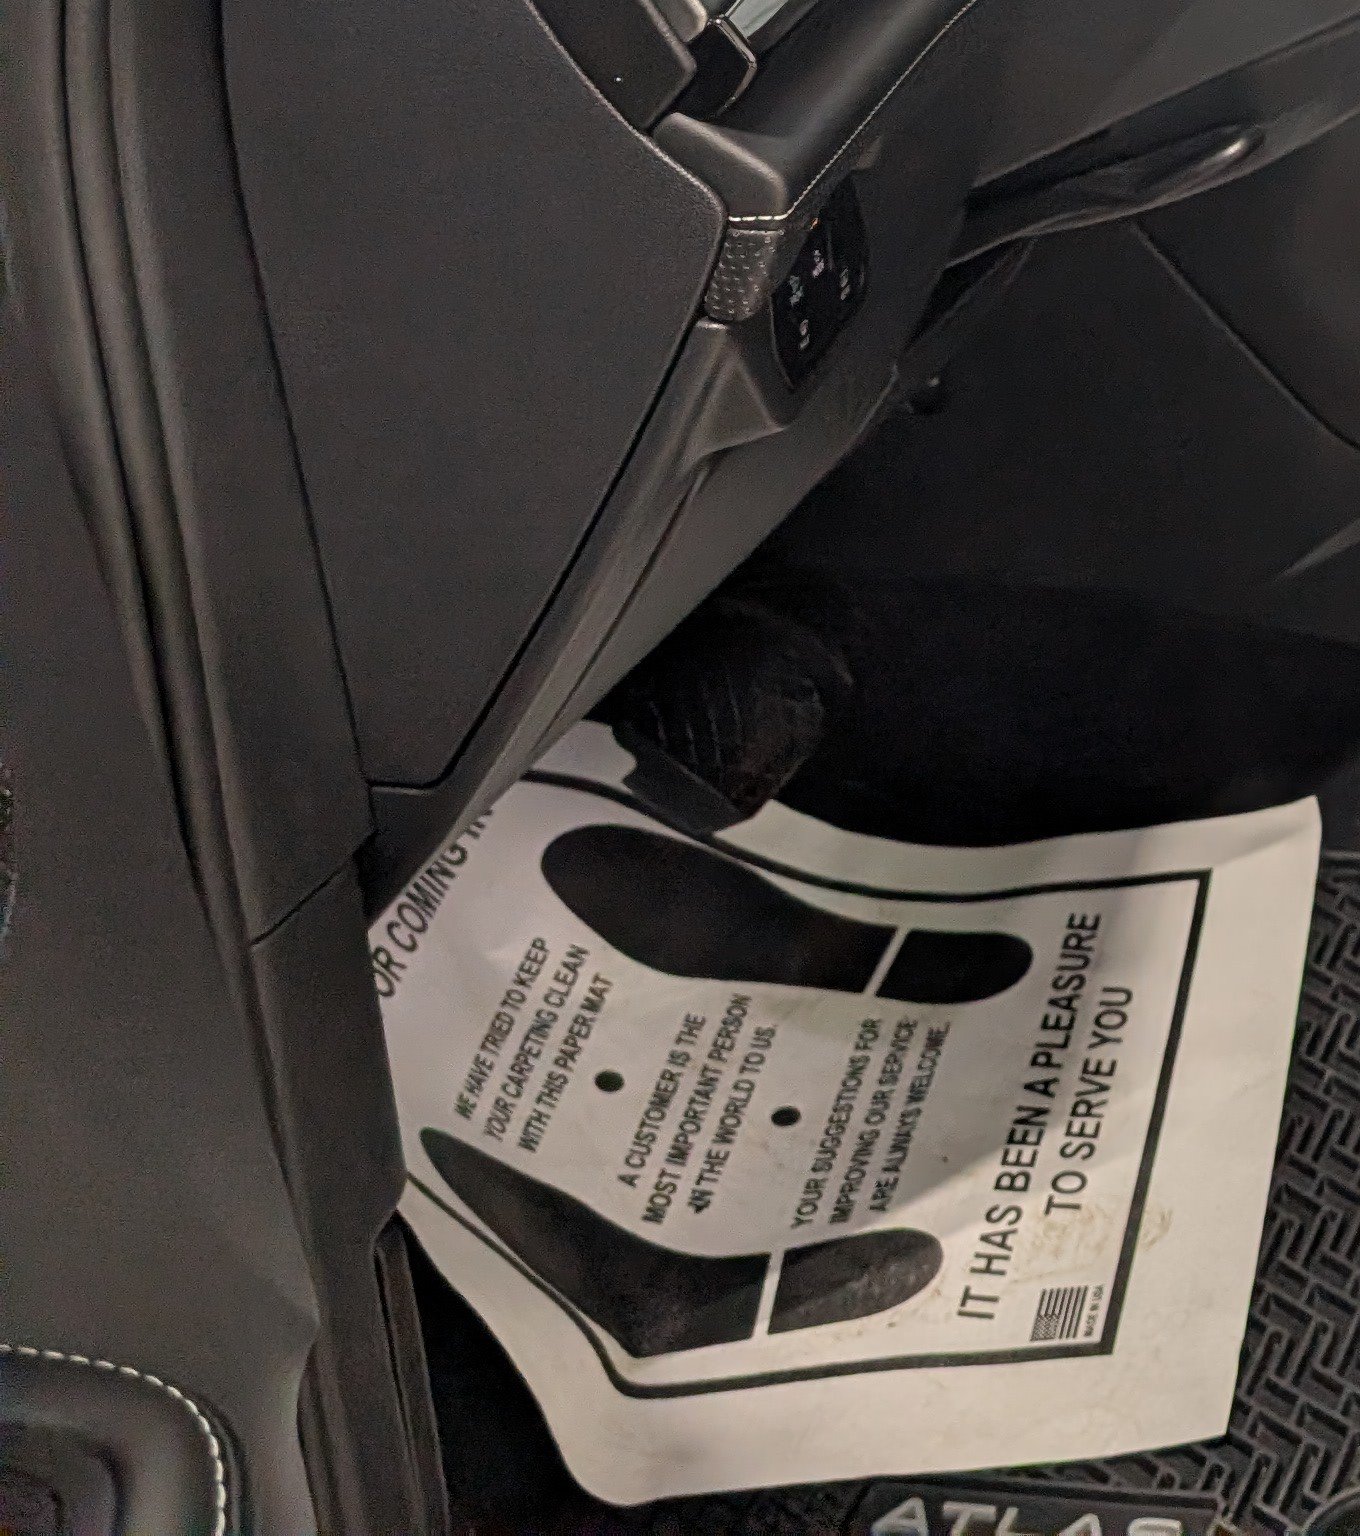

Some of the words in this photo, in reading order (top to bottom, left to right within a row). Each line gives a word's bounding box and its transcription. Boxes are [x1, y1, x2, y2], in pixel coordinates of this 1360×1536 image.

[387, 844, 468, 952] COMING
[513, 937, 549, 989] KEEP
[1030, 912, 1102, 1072] PLEASURE
[501, 988, 527, 1011] TO
[676, 1012, 706, 1046] THE
[1089, 986, 1134, 1053] YOU
[480, 1012, 515, 1056] TRIED
[484, 1096, 515, 1142] YOUR
[500, 1009, 559, 1099] CARPETING
[543, 944, 590, 1008] CLEAN
[518, 1108, 551, 1153] WITH
[536, 1070, 569, 1109] THIS
[554, 1014, 596, 1072] PAPER
[581, 971, 614, 1015] MAT
[666, 1050, 691, 1067] IS
[878, 1015, 919, 1087] SERVICE
[455, 1092, 477, 1120] WE
[464, 1054, 494, 1097] HAVE
[641, 1168, 682, 1225] MOST
[664, 1063, 723, 1167] IMPORTANT
[707, 992, 752, 1063] PERSON
[864, 1088, 896, 1126] OUR
[1023, 1076, 1059, 1101] A
[624, 1069, 682, 1168] CUSTOMER
[695, 1149, 729, 1186] THE
[712, 1079, 756, 1145] WORLD
[739, 1051, 766, 1076] TO
[790, 1177, 828, 1229] YOUR
[811, 1054, 871, 1173] SUGGESTIONS
[855, 1017, 882, 1051] FOR
[882, 1107, 923, 1173] ALWAYS
[1059, 1058, 1118, 1161] SERVE
[617, 1172, 641, 1188] A
[828, 1128, 881, 1225] IMPROVING
[994, 1105, 1050, 1194] BEEN
[869, 1176, 900, 1212] ARE
[1044, 1169, 1088, 1217] TO
[970, 1204, 1023, 1276] HAS
[956, 1286, 1000, 1320] IT
